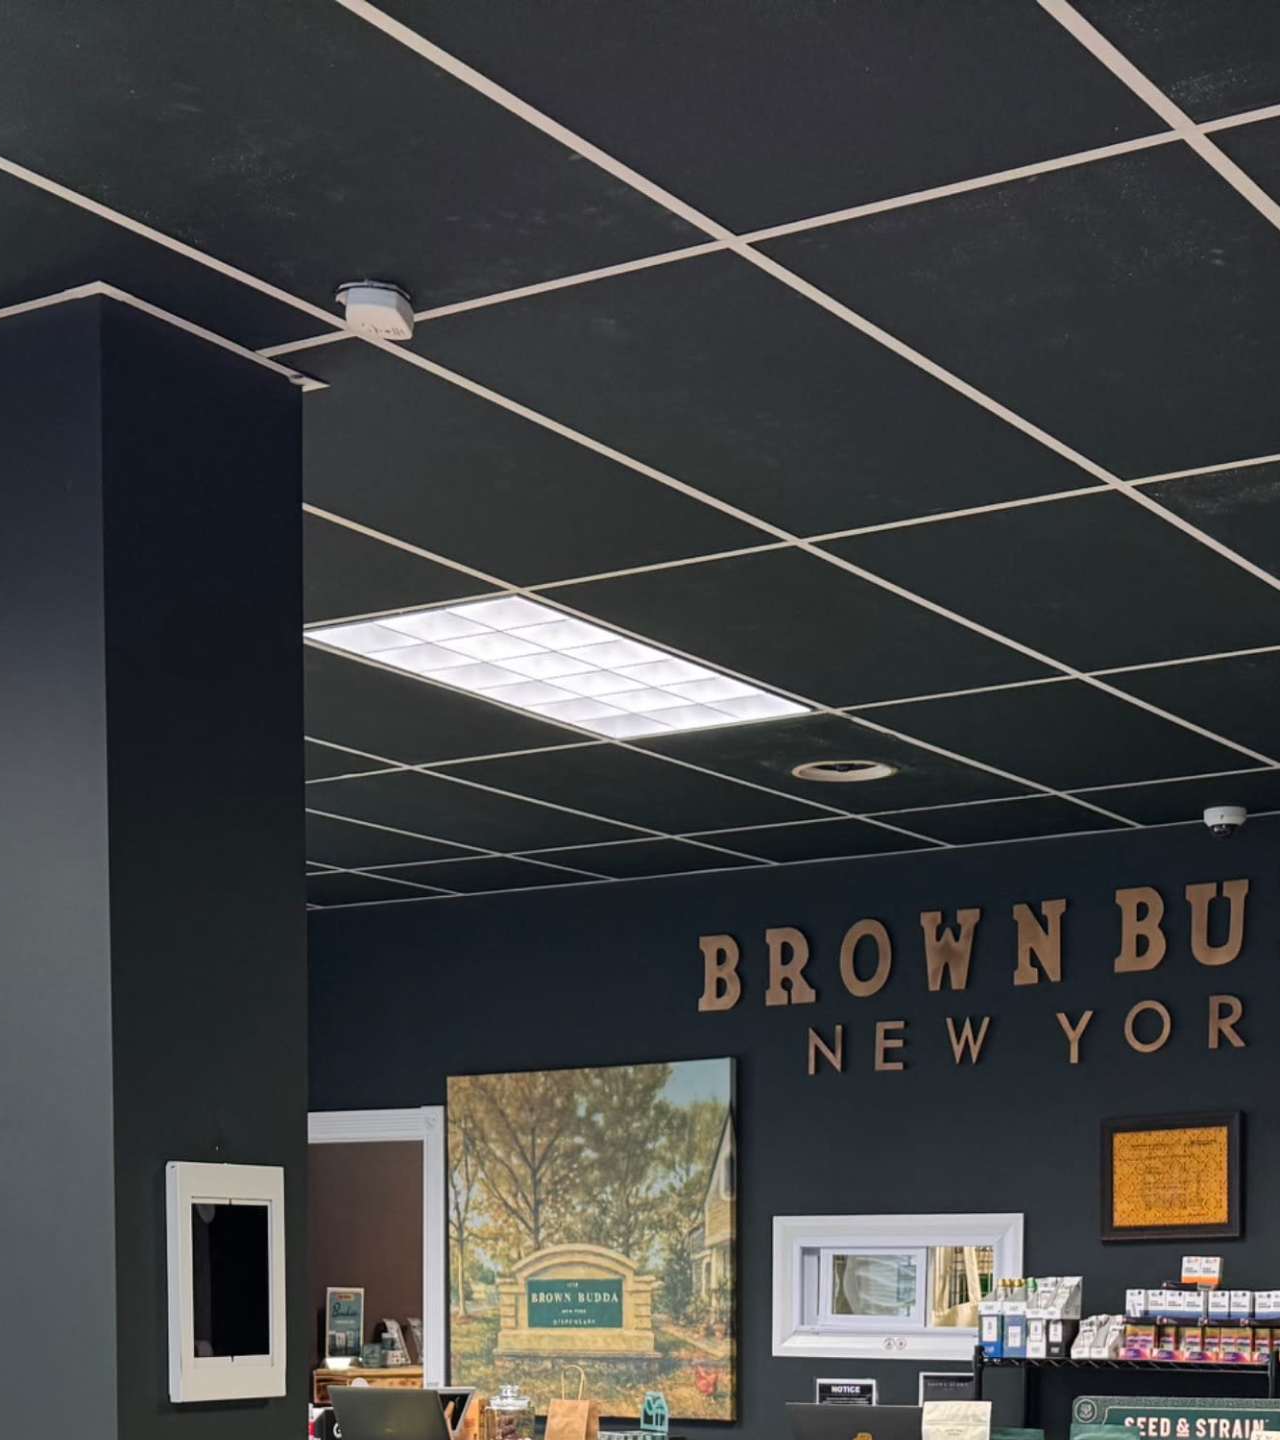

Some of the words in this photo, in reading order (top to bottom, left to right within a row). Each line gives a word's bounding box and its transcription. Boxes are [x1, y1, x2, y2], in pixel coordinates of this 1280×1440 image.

[697, 898, 1068, 1012] BROWN
[806, 1015, 991, 1076] NEW
[531, 1292, 572, 1303] BROWN
[578, 1292, 619, 1303] BUDDA
[830, 1385, 862, 1394] NOTICE
[1176, 1417, 1190, 1438] &
